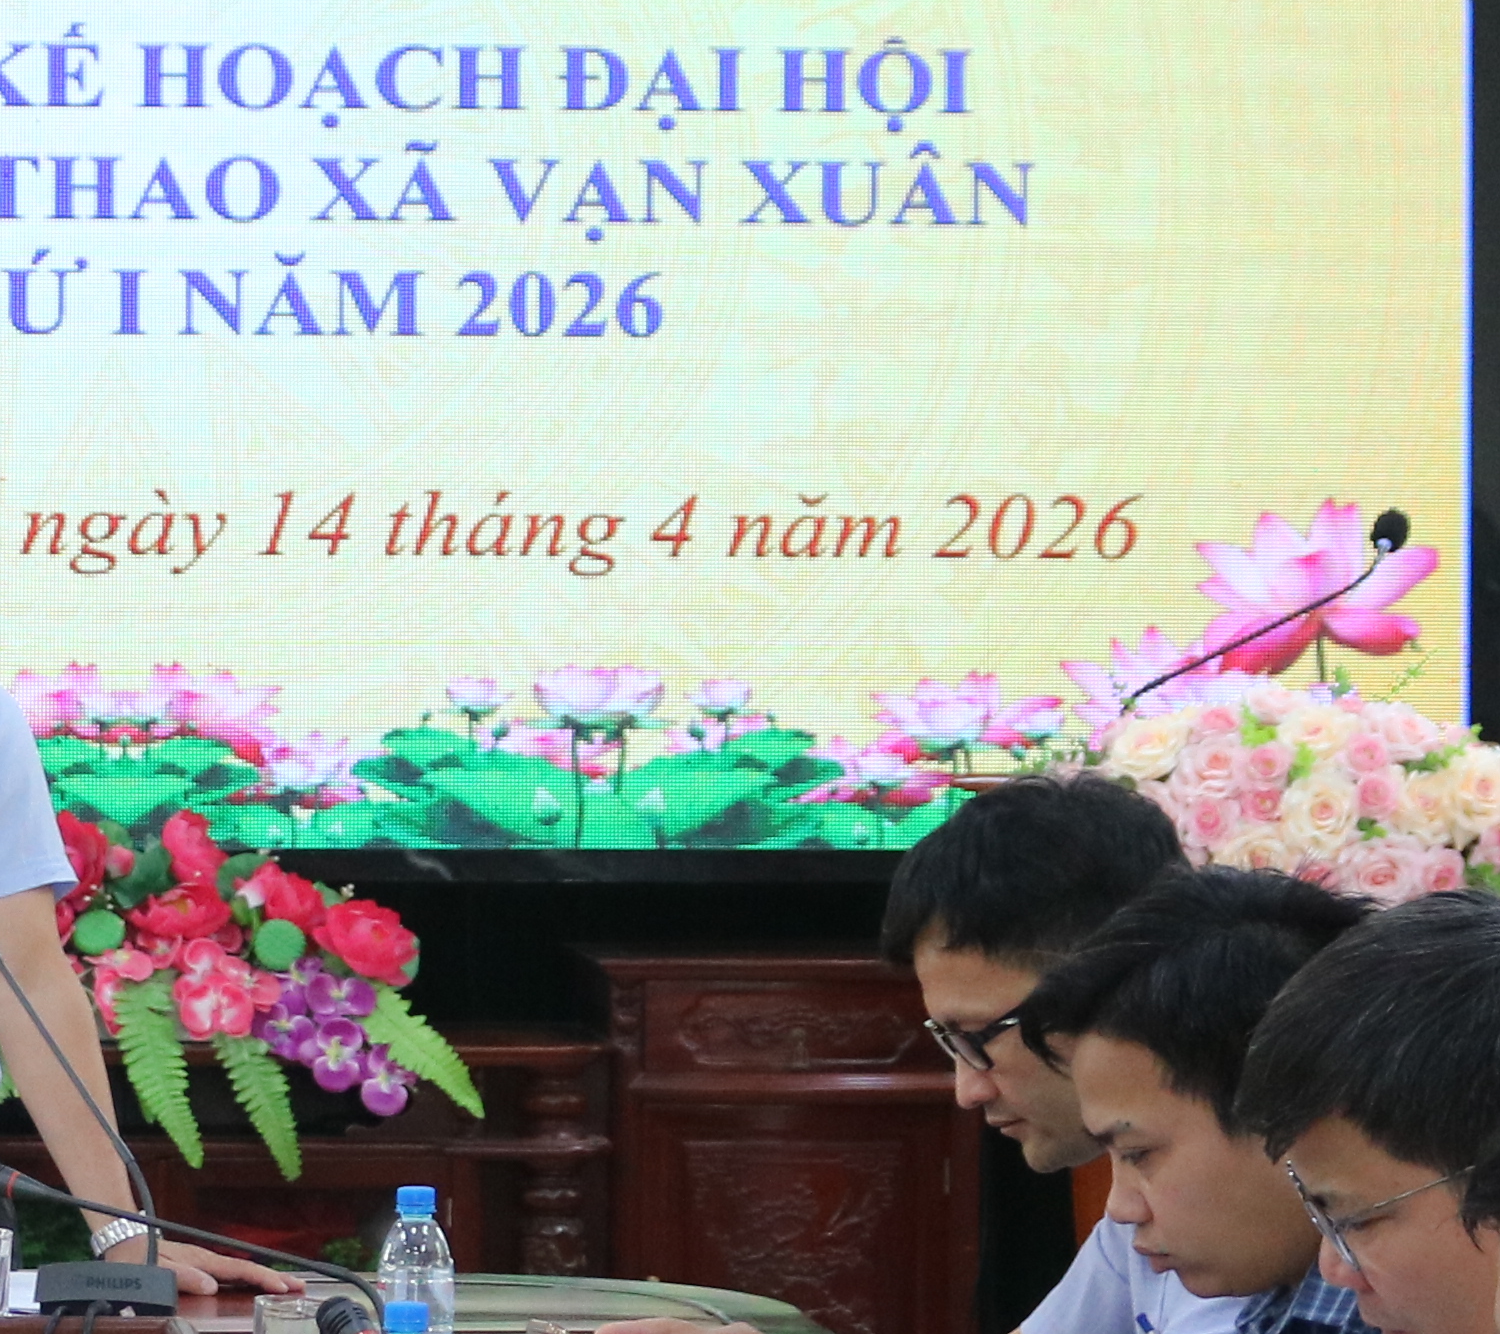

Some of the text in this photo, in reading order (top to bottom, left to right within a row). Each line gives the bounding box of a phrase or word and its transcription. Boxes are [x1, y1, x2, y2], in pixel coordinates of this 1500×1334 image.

[135, 43, 527, 128] HOẠCH
[558, 45, 745, 131] ĐẠI
[775, 37, 972, 133] HỘI
[310, 140, 455, 222] XÃ
[490, 158, 708, 243] VẠN
[740, 139, 1035, 228] XUÂN
[112, 268, 148, 337] I
[178, 251, 428, 337] NĂM
[456, 270, 666, 338] 2026
[20, 489, 228, 574] ngày
[259, 489, 357, 556] 14
[385, 490, 626, 576] tháng
[651, 493, 699, 558] 4
[726, 492, 903, 559] năm
[931, 492, 1141, 561] 2026
[86, 1276, 142, 1291] PHILIPS
